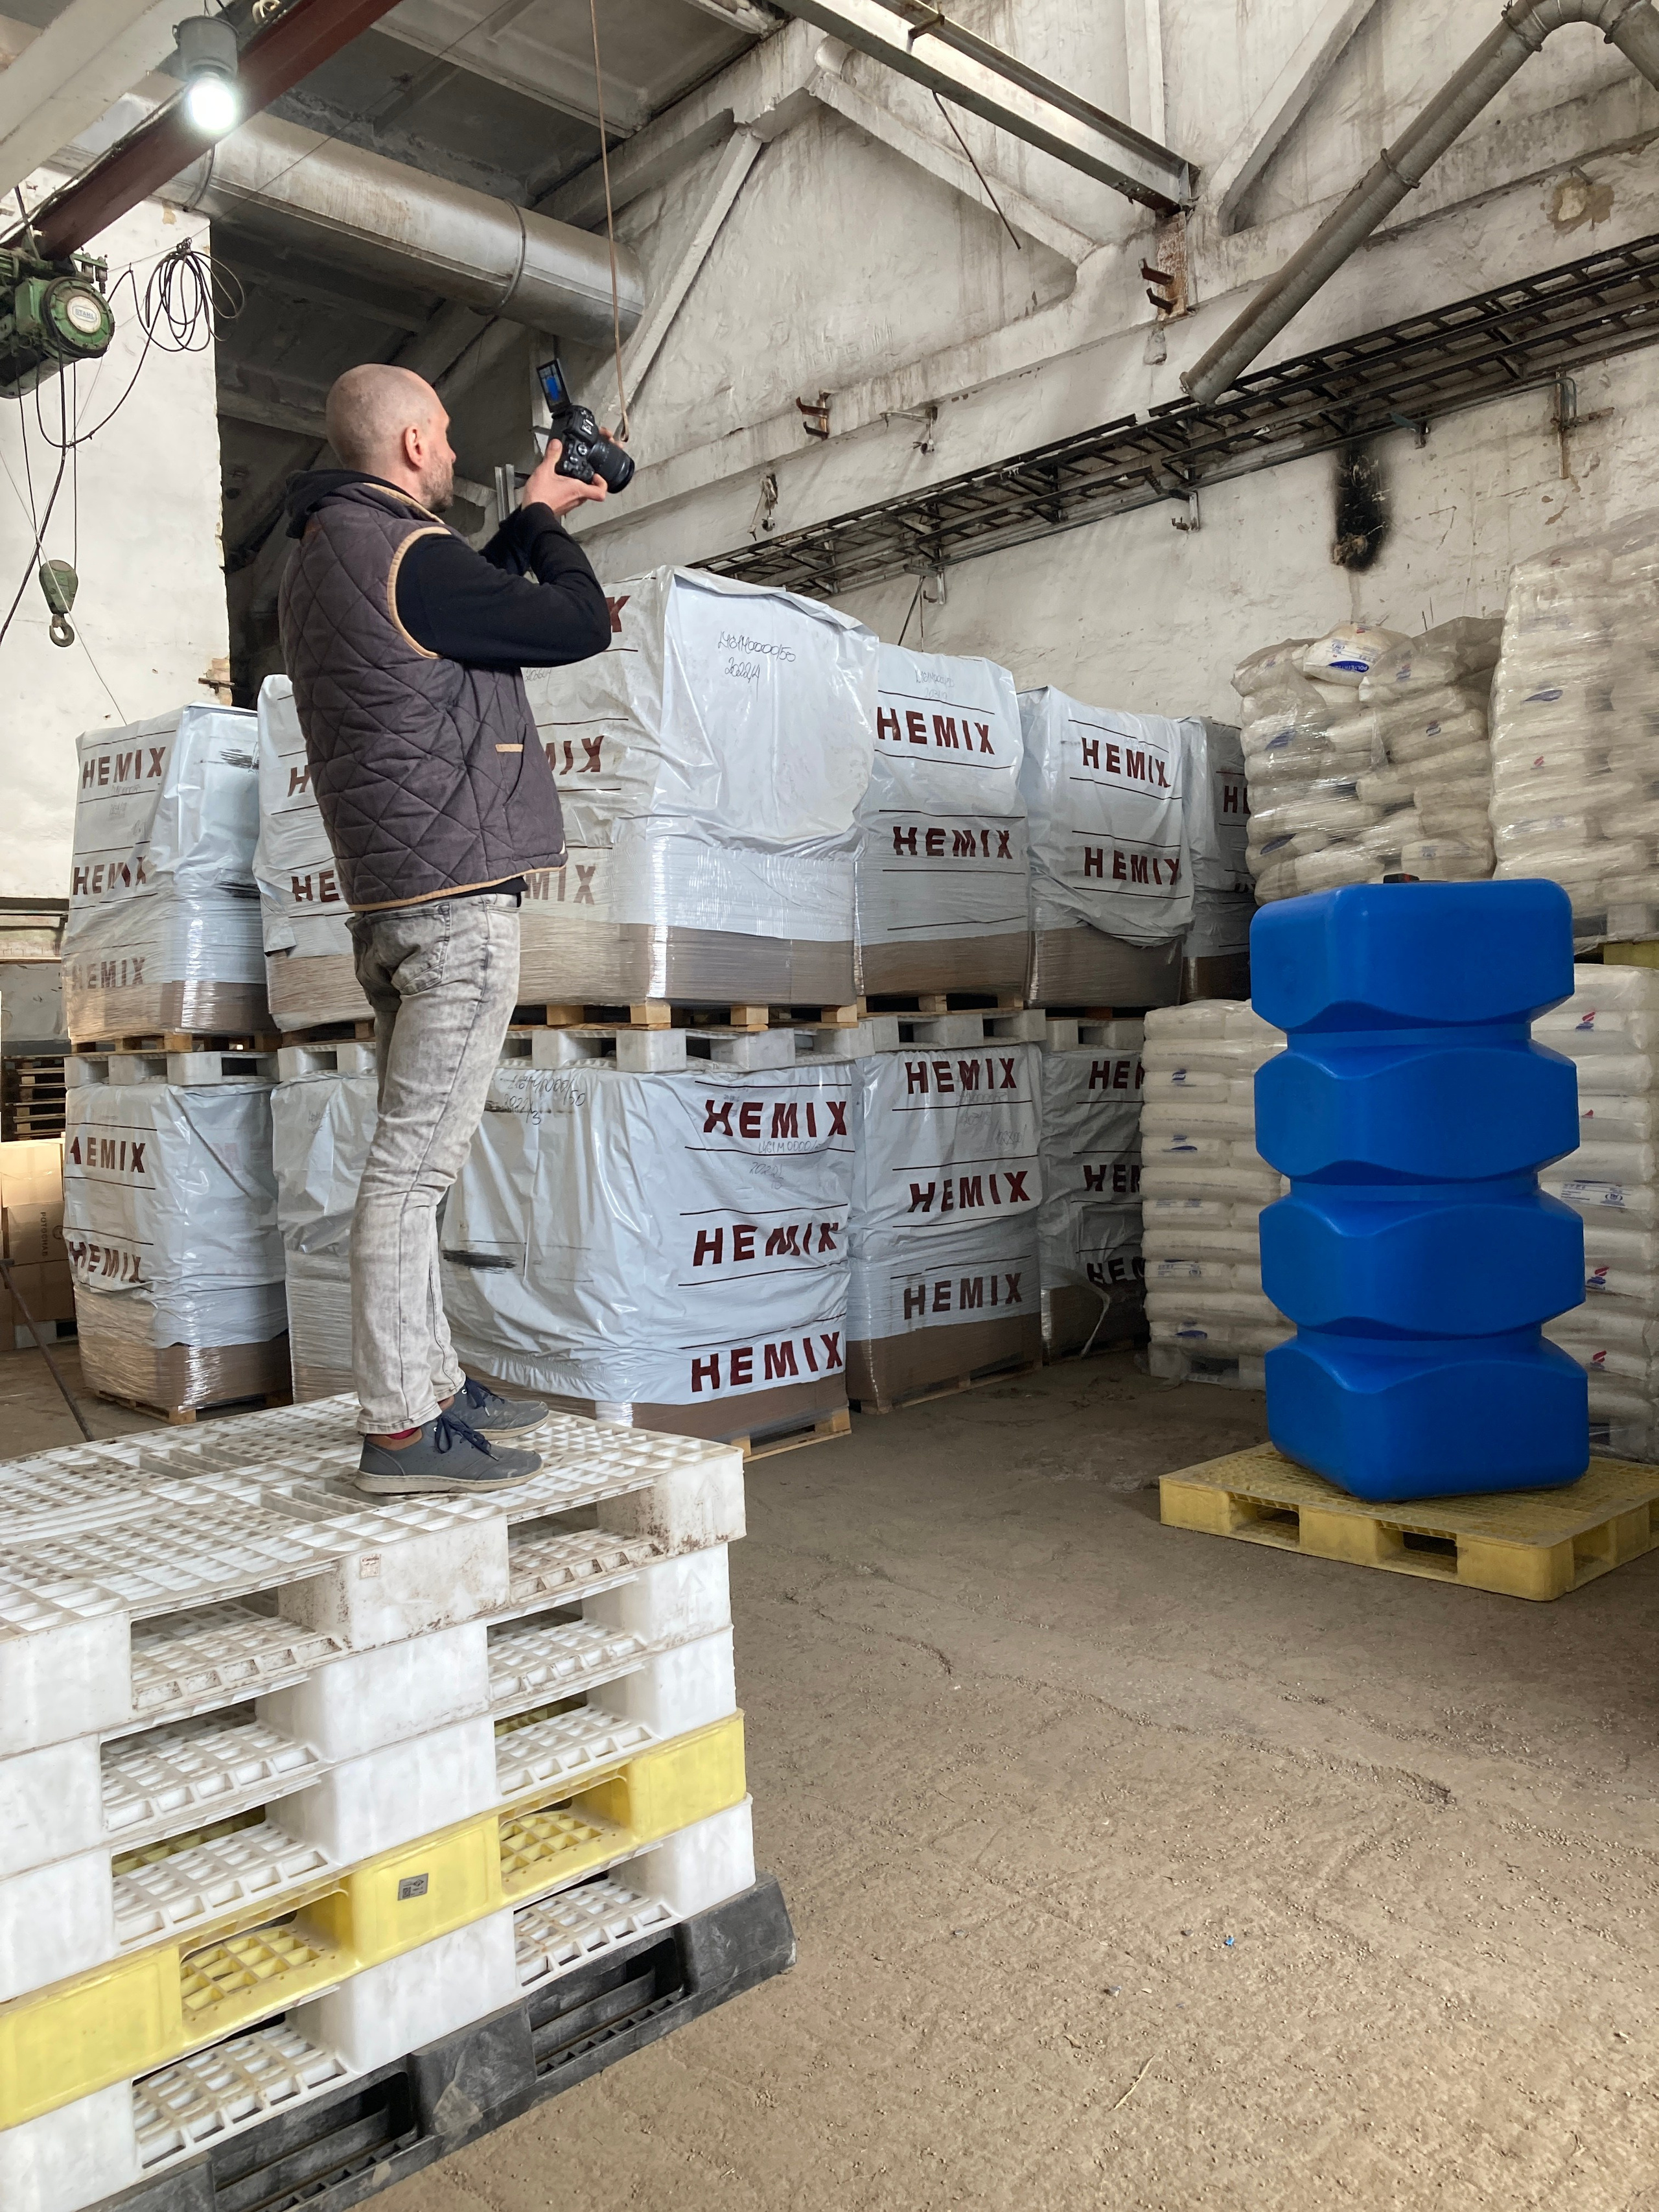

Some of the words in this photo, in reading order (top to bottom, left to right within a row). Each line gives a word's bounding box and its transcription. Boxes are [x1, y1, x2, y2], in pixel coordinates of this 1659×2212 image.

[75, 309, 95, 320] STAHL
[877, 706, 995, 754] HEMIX
[82, 746, 166, 789] HEMIX
[1082, 736, 1171, 788] HEMIX
[893, 826, 1013, 860] HEMIX
[71, 957, 146, 991] HEMIX
[905, 1057, 1017, 1095] HEMIX
[704, 1099, 848, 1139] HEMIX
[907, 1170, 1031, 1213] HEMIX
[69, 1242, 143, 1283] HEMIX
[693, 1222, 839, 1267] HEMIX
[903, 1272, 1023, 1320] HEMIX
[691, 1331, 843, 1393] HEMIX
